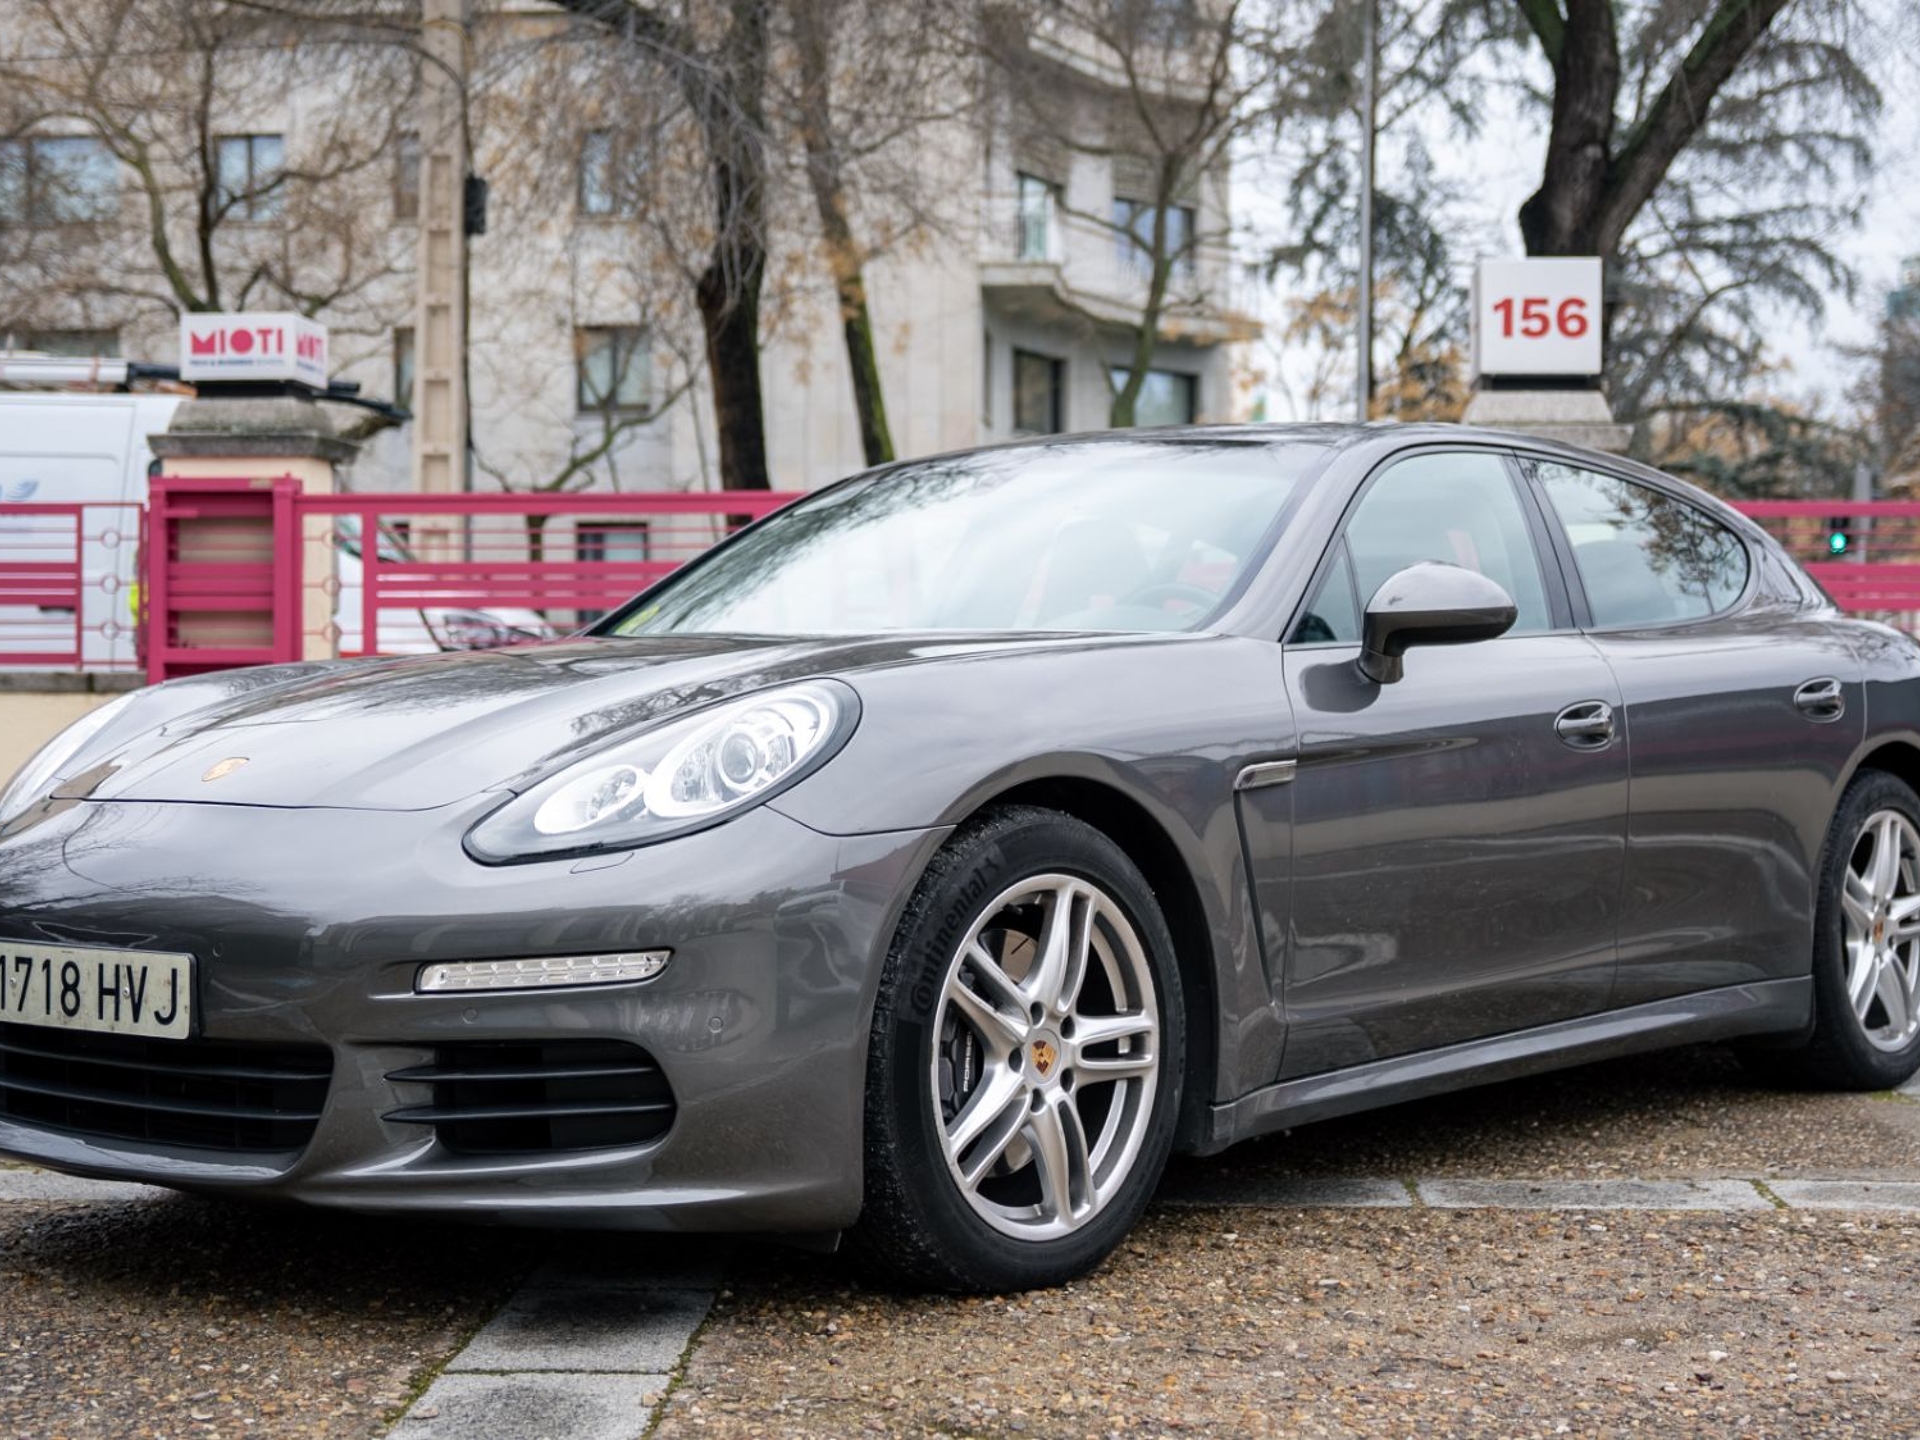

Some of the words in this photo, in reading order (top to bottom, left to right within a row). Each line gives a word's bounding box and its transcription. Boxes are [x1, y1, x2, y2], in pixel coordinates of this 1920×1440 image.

[190, 328, 284, 355] MIOTI
[1492, 297, 1589, 338] 156
[911, 867, 988, 1016] Continental
[0, 954, 81, 1018] 1718
[98, 962, 178, 1026] HVJ
